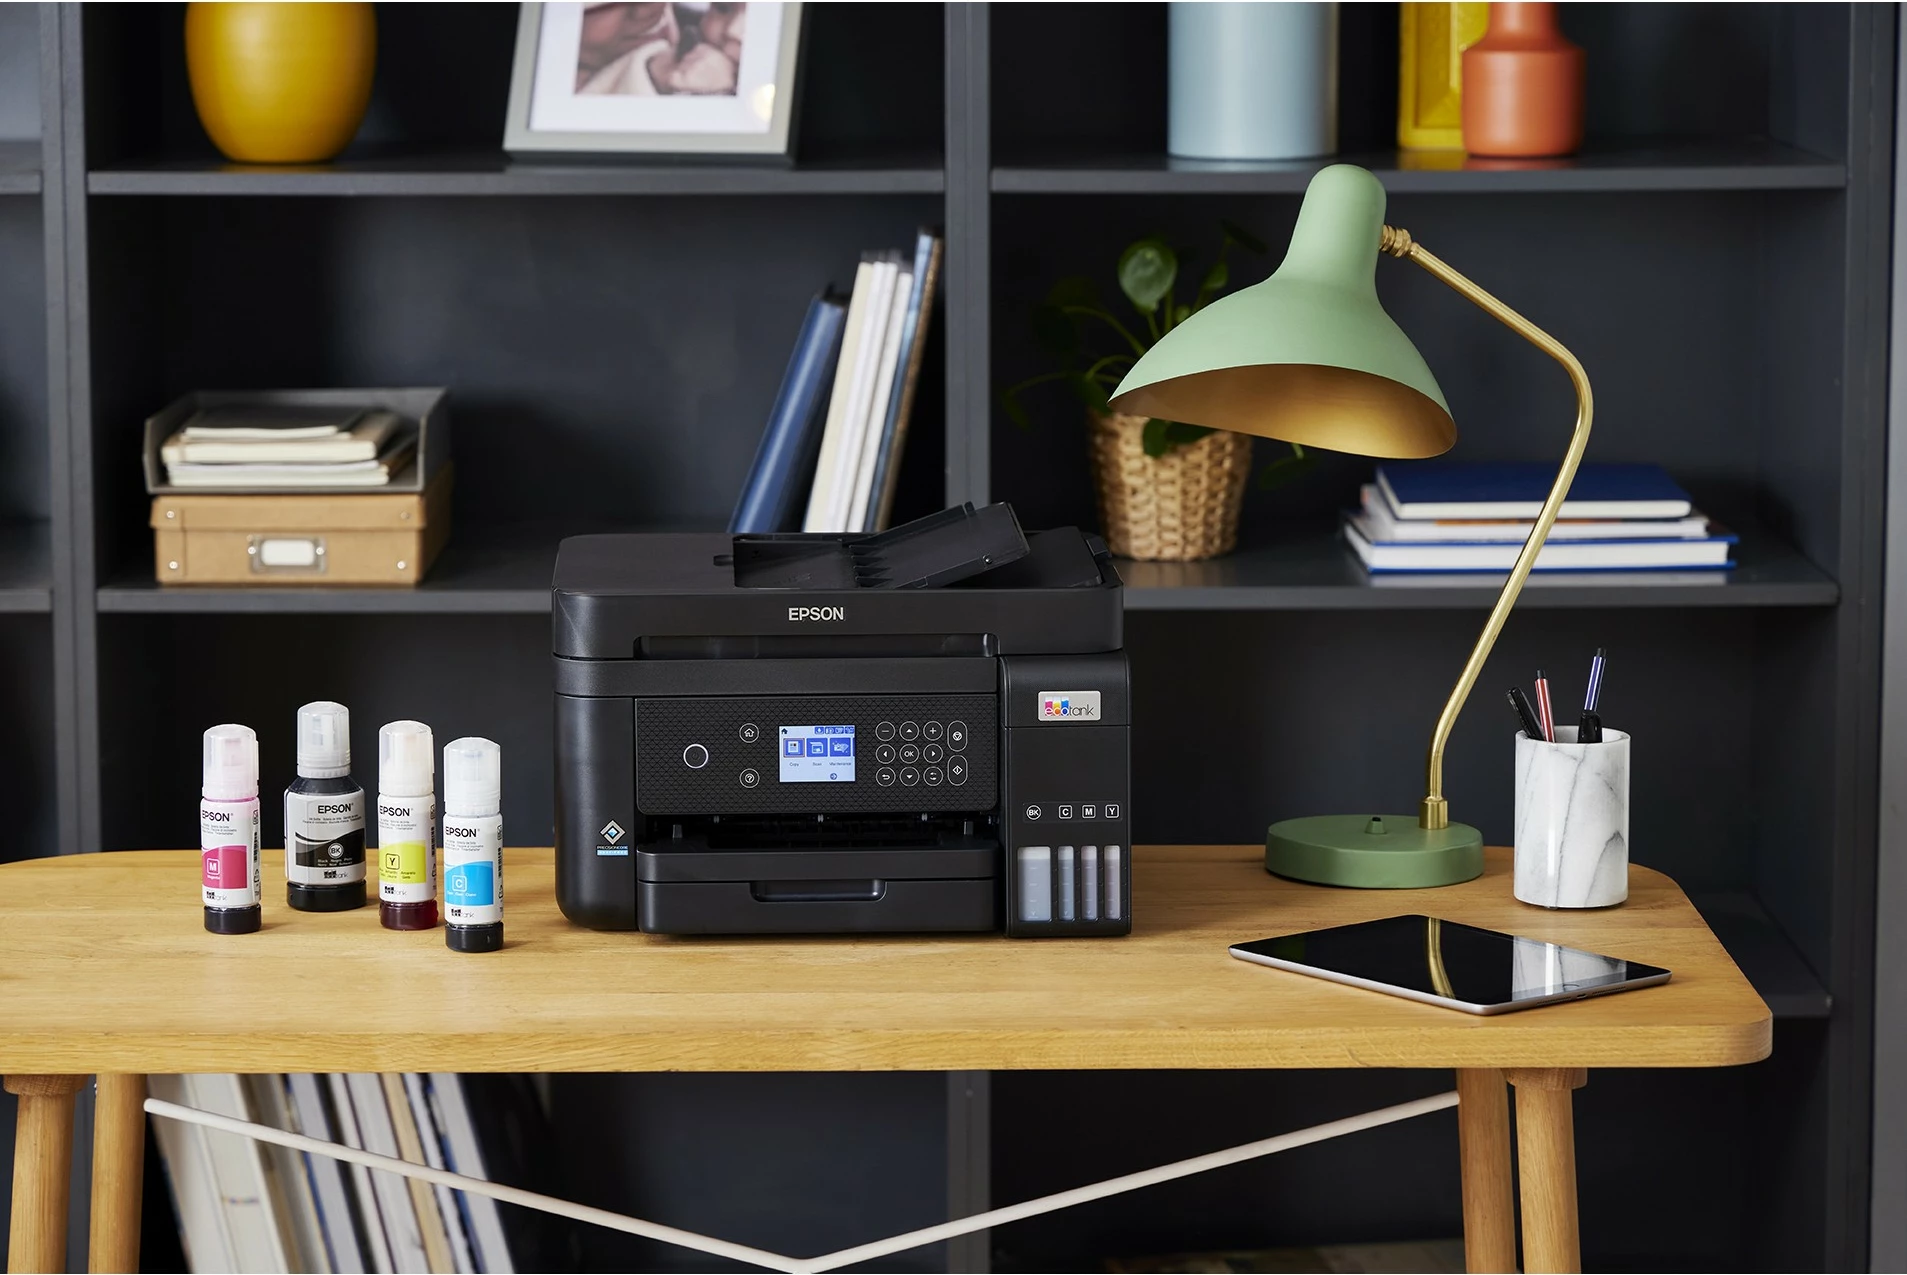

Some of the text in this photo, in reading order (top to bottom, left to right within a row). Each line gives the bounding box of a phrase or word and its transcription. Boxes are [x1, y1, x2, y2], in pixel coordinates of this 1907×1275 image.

[789, 607, 844, 621] EPSON
[318, 803, 352, 814] EPSON
[379, 805, 410, 816] EPSON
[1062, 808, 1069, 816] C
[1109, 807, 1115, 815] Y
[202, 810, 230, 821] EPSON
[445, 826, 477, 837] EPSON
[209, 862, 217, 871] M
[389, 857, 396, 866] Y
[455, 880, 463, 888] C
